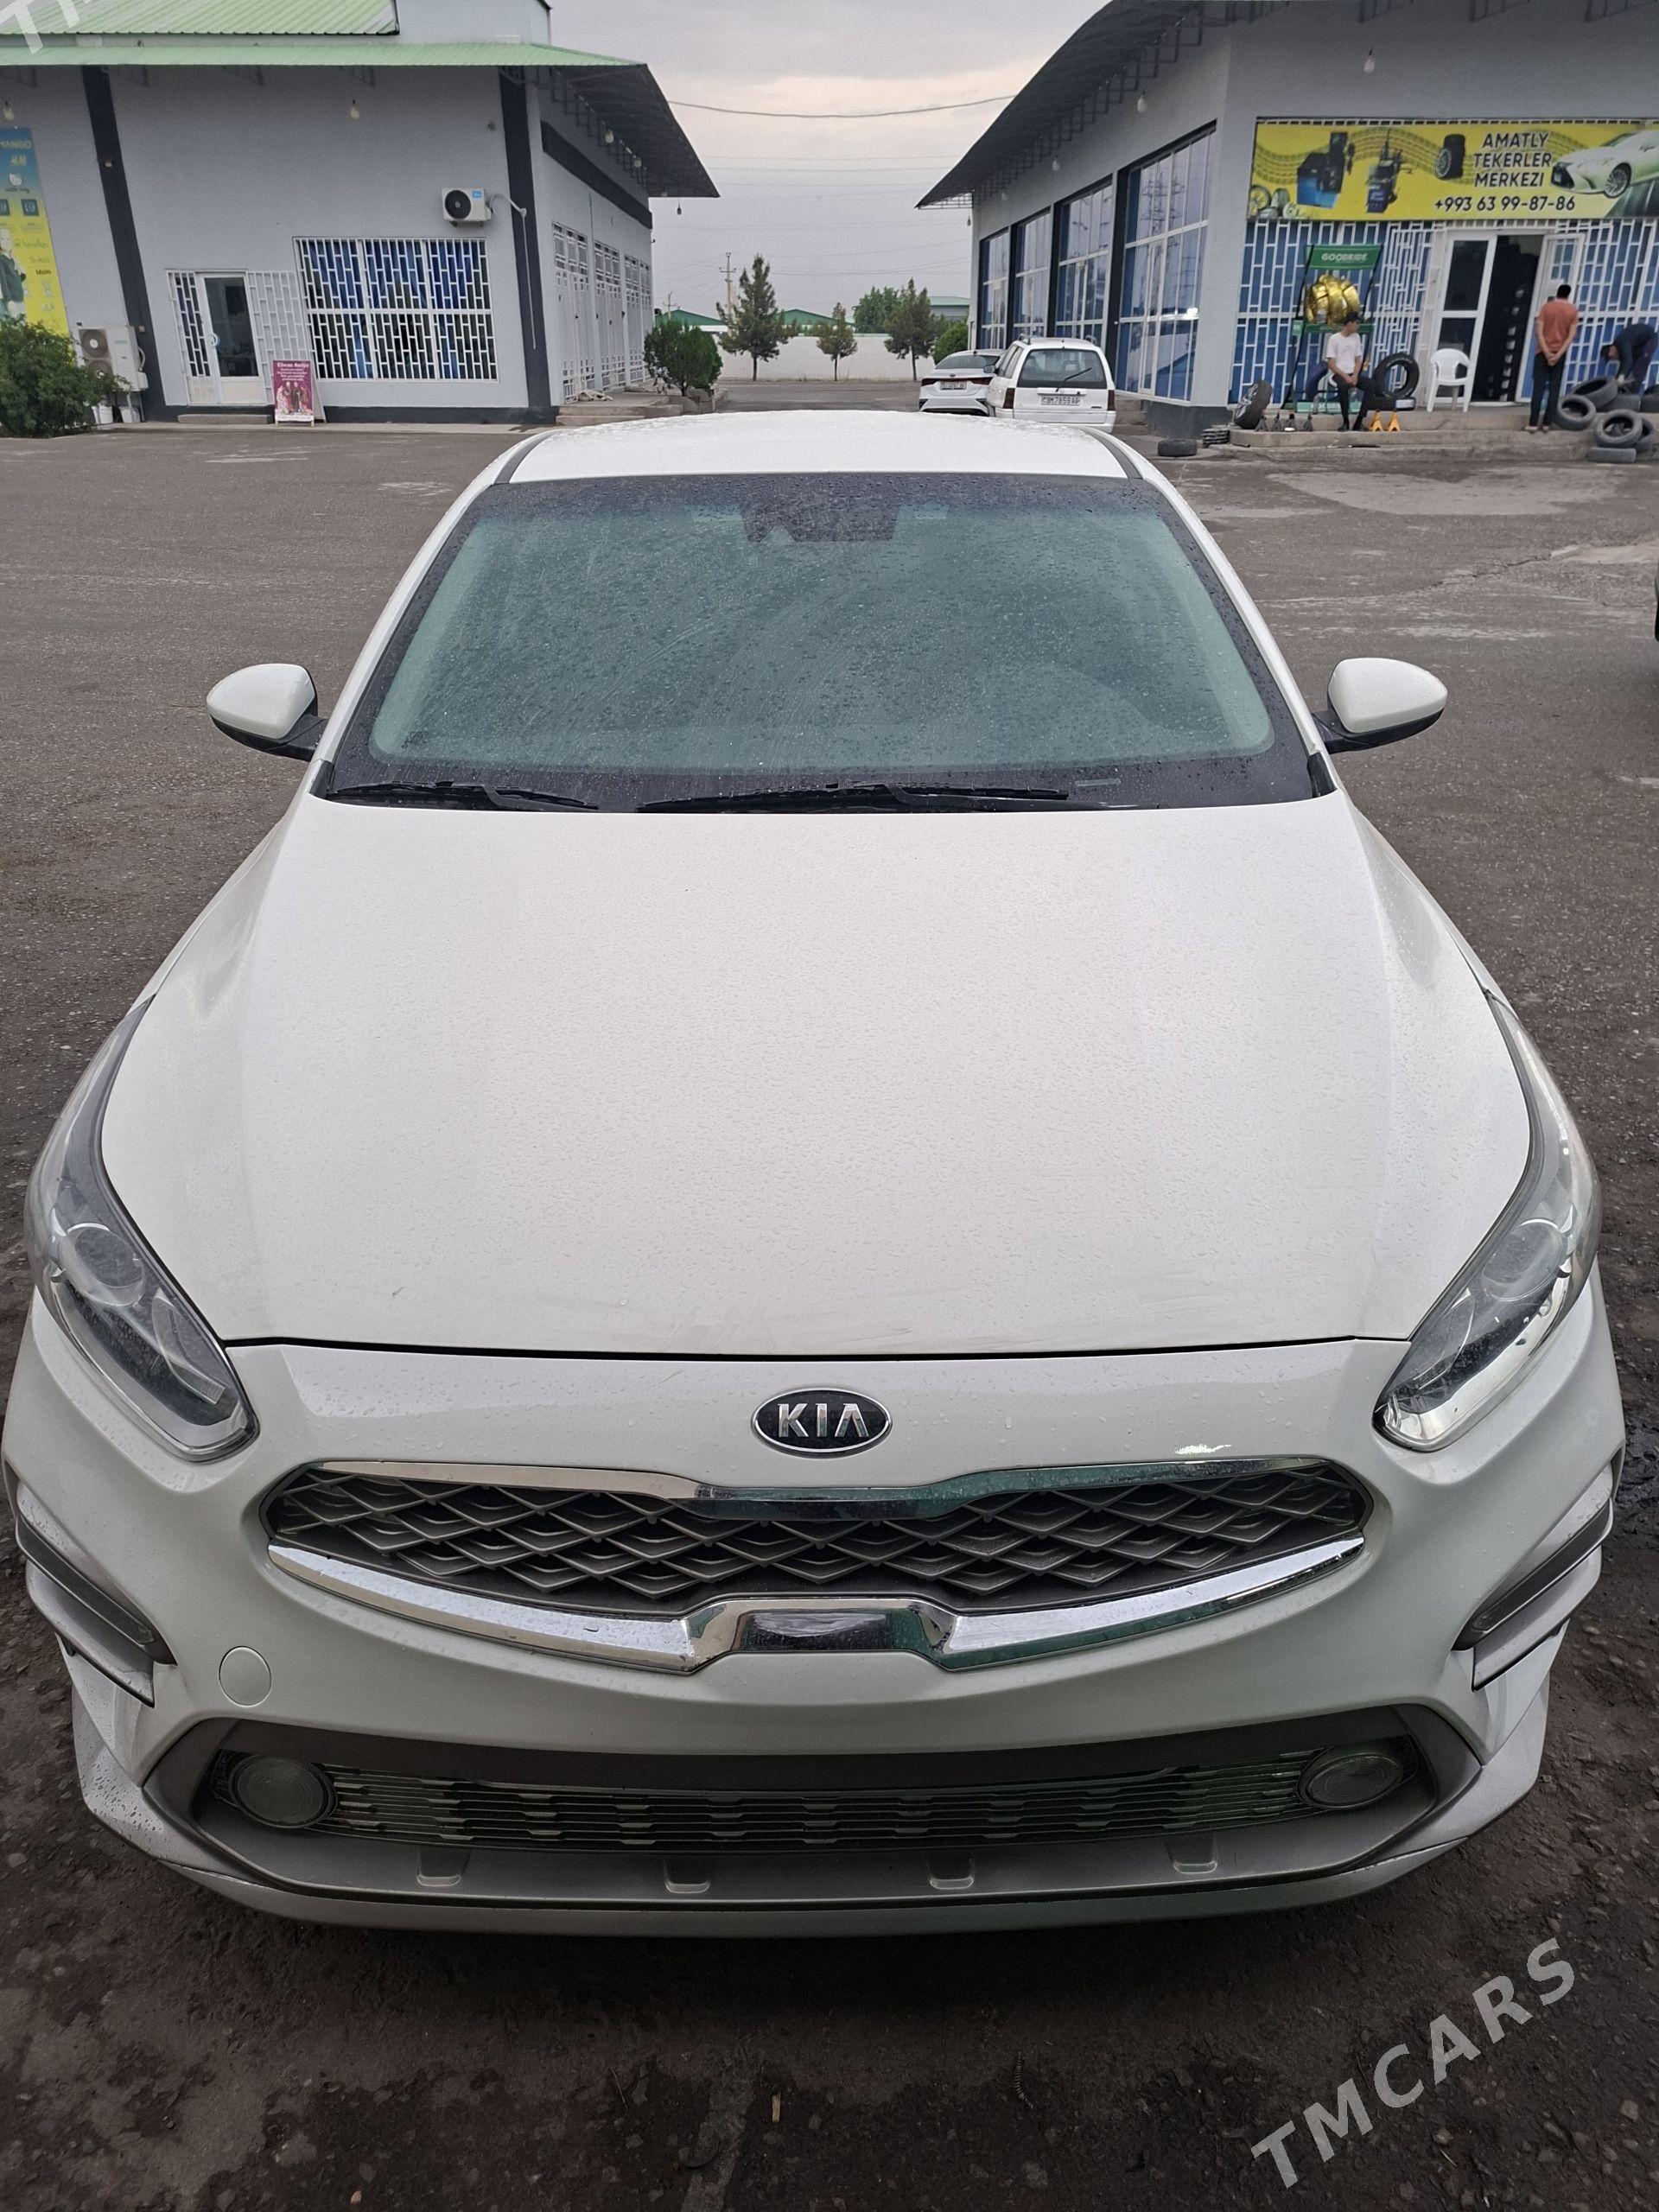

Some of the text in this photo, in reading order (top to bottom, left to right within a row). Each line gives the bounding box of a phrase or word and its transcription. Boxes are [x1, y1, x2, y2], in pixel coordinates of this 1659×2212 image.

[1482, 133, 1549, 149] AMATLY
[1473, 153, 1552, 168] TEKERLER
[1474, 173, 1544, 188] MERKEZI
[1434, 196, 1575, 212] +993 63 99-87-86
[778, 1403, 869, 1438] KIA
